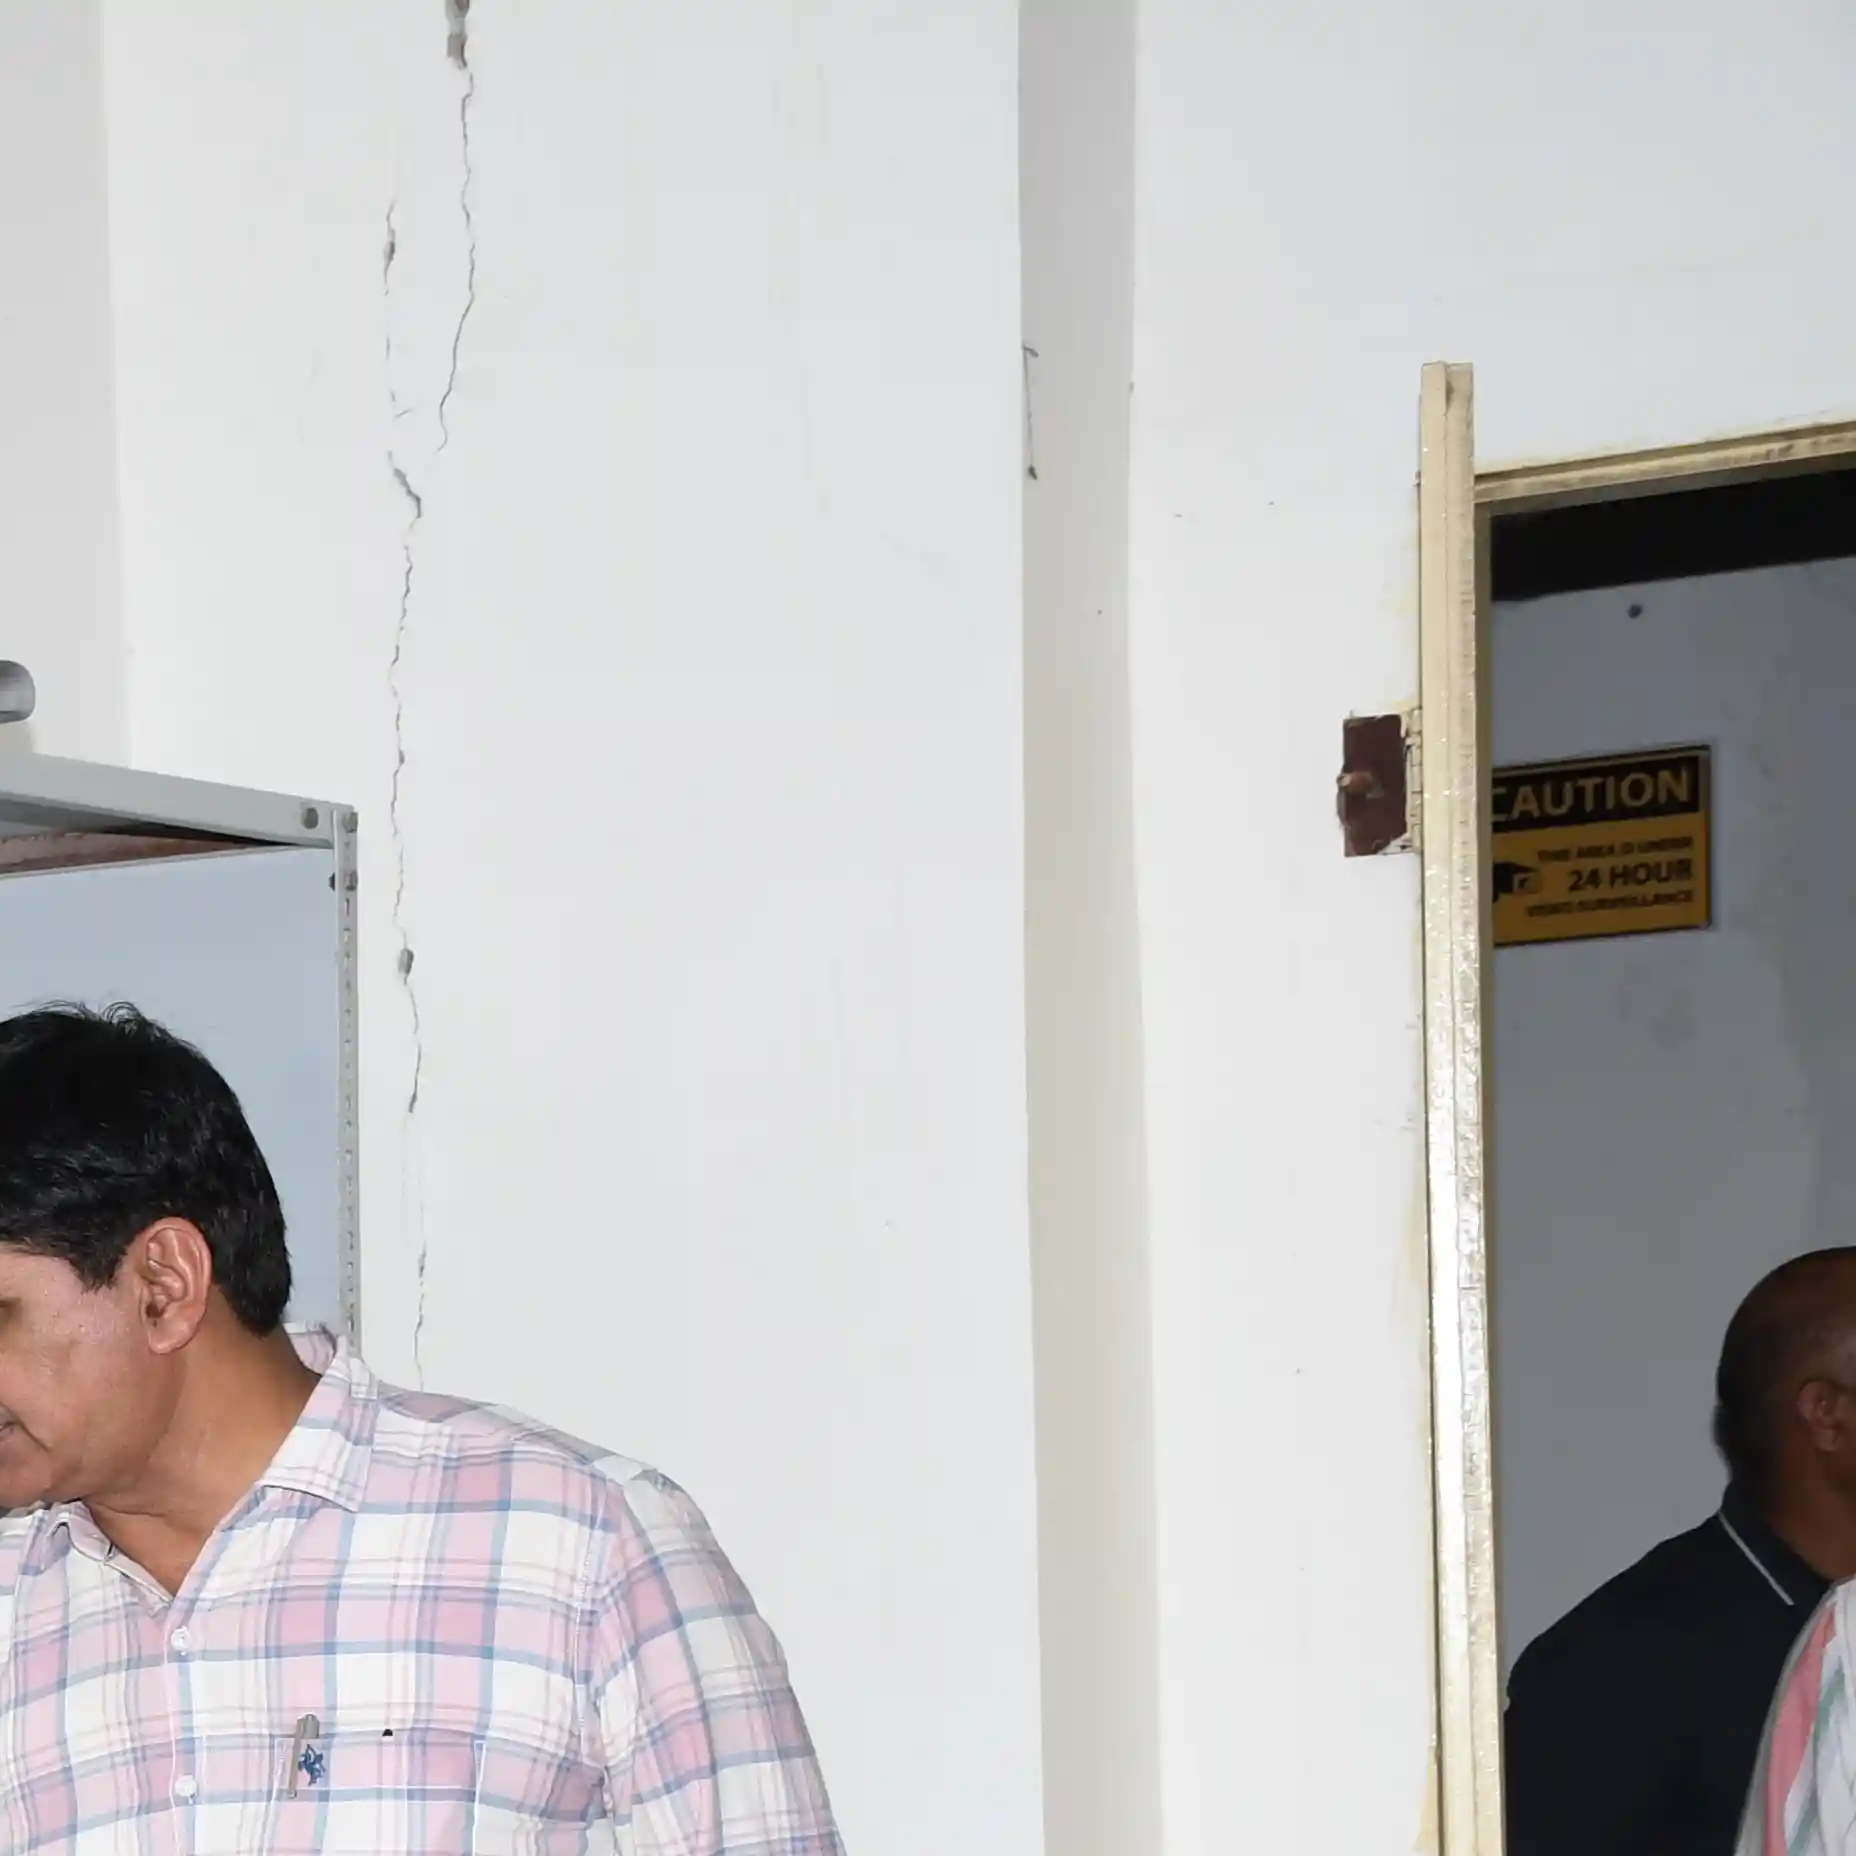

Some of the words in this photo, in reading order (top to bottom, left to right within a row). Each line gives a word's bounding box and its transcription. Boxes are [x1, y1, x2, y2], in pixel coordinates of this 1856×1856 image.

[1492, 768, 1688, 822] CAUTION
[1569, 869, 1602, 892] 24
[1609, 858, 1692, 887] HOUR
